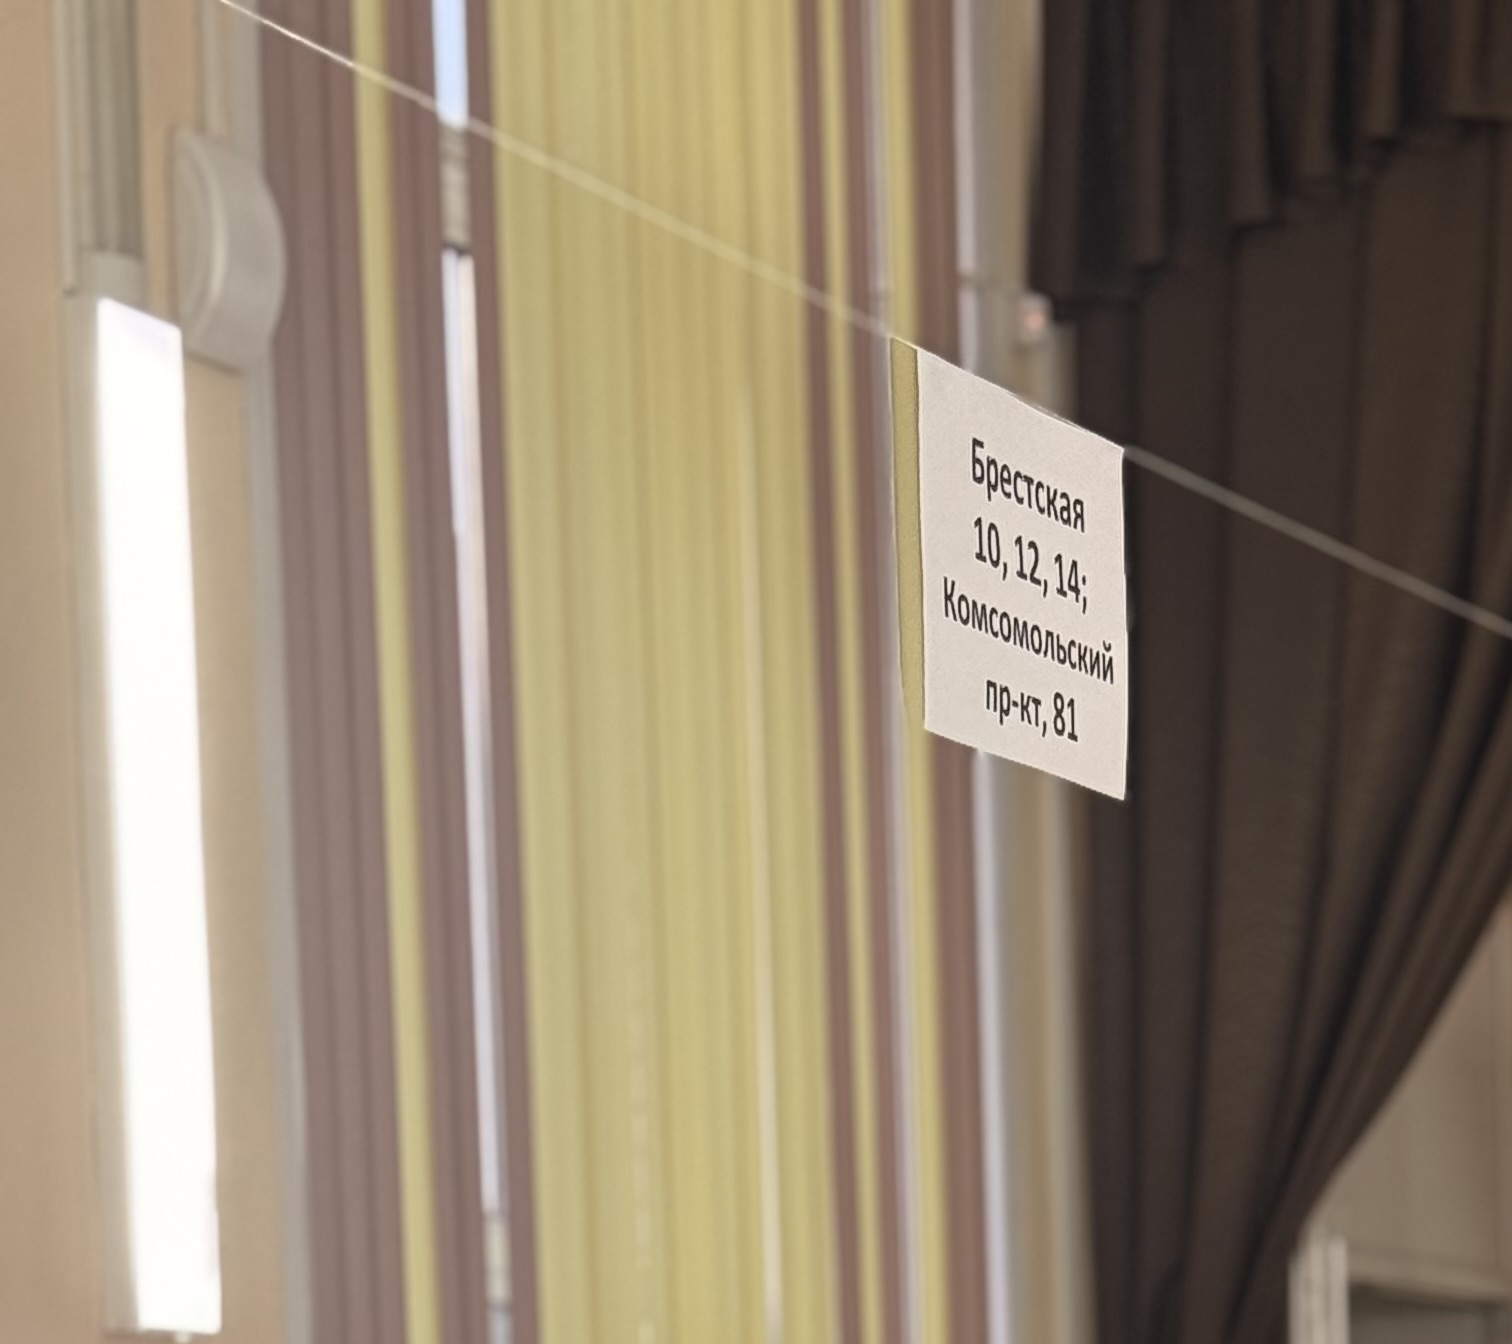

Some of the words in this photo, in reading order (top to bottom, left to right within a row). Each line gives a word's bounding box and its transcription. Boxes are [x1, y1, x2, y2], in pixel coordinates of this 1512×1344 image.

[971, 437, 1086, 534] Брестская
[974, 516, 1009, 582] 10,
[1013, 534, 1049, 600] 12,
[1053, 552, 1088, 616] 14;
[942, 575, 1115, 686] Комсомольский
[985, 678, 1048, 739] пр-кт,
[1052, 691, 1079, 744] 81
